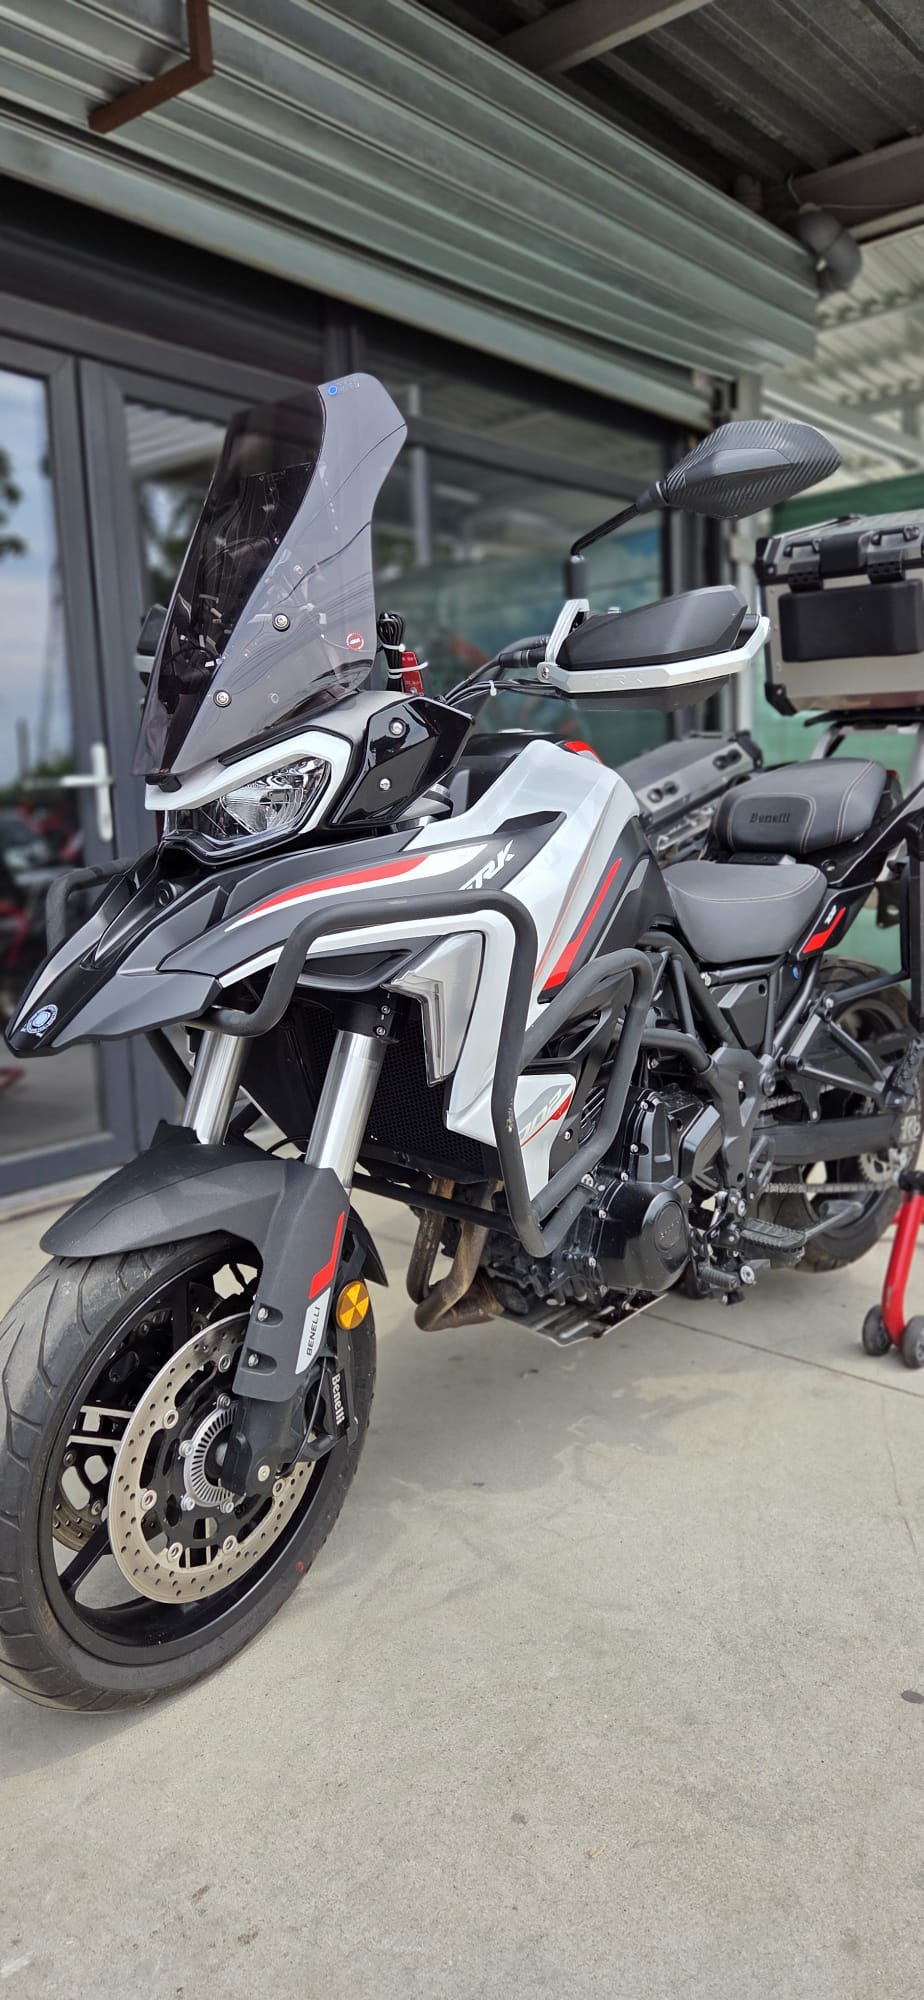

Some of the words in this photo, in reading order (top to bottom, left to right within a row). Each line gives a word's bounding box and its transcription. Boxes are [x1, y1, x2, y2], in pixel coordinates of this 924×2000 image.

[749, 812, 791, 823] Benelli
[306, 1306, 321, 1356] BENELLI
[331, 1373, 346, 1425] Benelli
